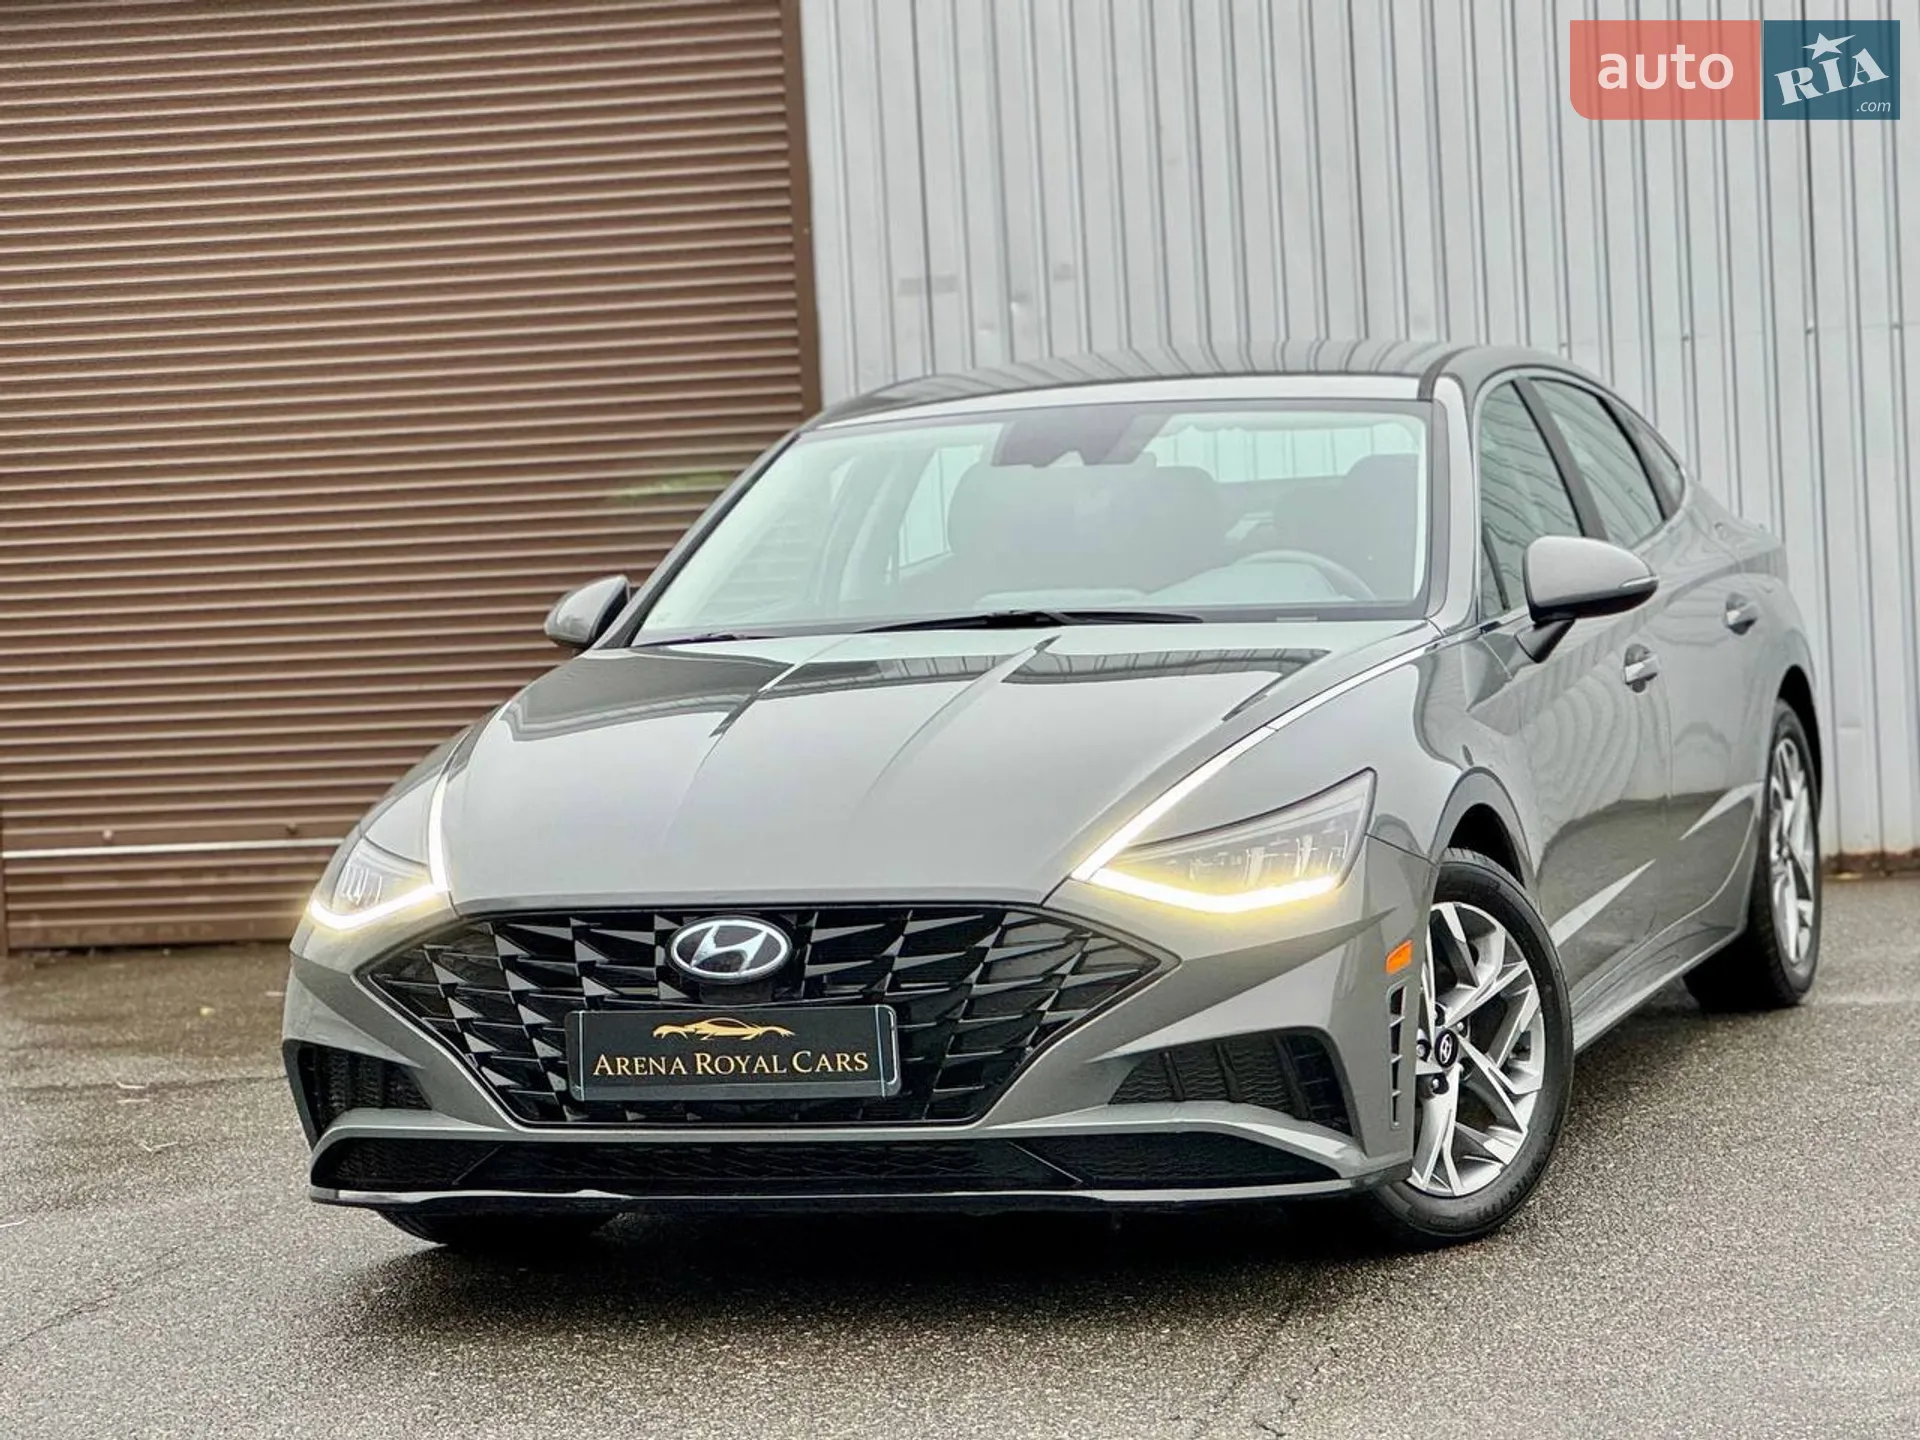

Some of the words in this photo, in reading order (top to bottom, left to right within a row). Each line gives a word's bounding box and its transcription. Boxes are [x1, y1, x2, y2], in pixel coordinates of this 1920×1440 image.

[593, 1054, 688, 1075] ARENA
[694, 1053, 787, 1074] ROYAL
[792, 1050, 868, 1073] CARS
